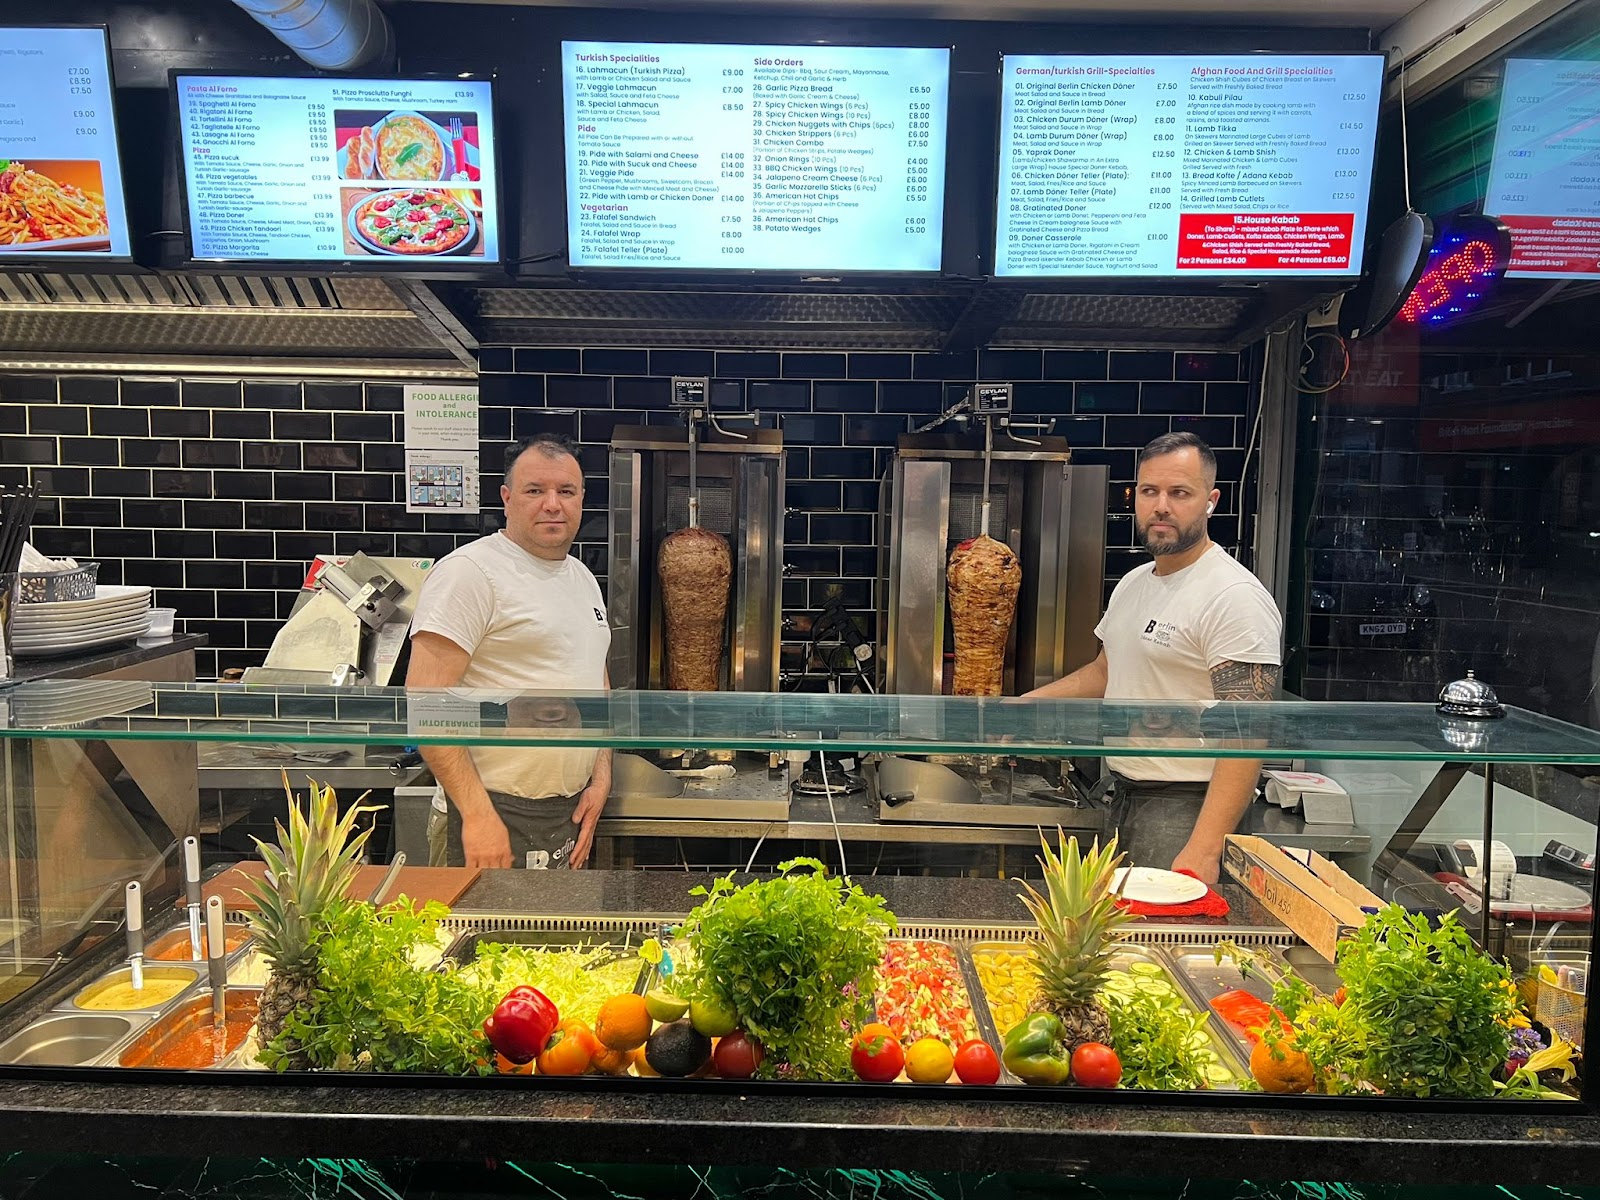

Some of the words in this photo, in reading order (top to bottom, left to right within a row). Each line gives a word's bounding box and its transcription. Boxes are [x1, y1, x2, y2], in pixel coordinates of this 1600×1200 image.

[575, 53, 608, 61] Turkish
[610, 54, 660, 64] Specialities
[630, 66, 661, 75] (Turkish
[663, 66, 685, 76] Pizza)
[1016, 66, 1084, 76] German/turkish
[1086, 67, 1155, 77] Grill-Specialties
[1191, 67, 1222, 77] Afghan
[1224, 67, 1245, 76] Food
[1284, 67, 1333, 77] Specialities
[587, 84, 614, 92] Veggie
[1026, 82, 1056, 92] Original
[1026, 149, 1052, 157] Yaprak
[580, 204, 628, 214] Vegetarian
[791, 226, 821, 234] Wedges
[1278, 899, 1291, 914] 450
